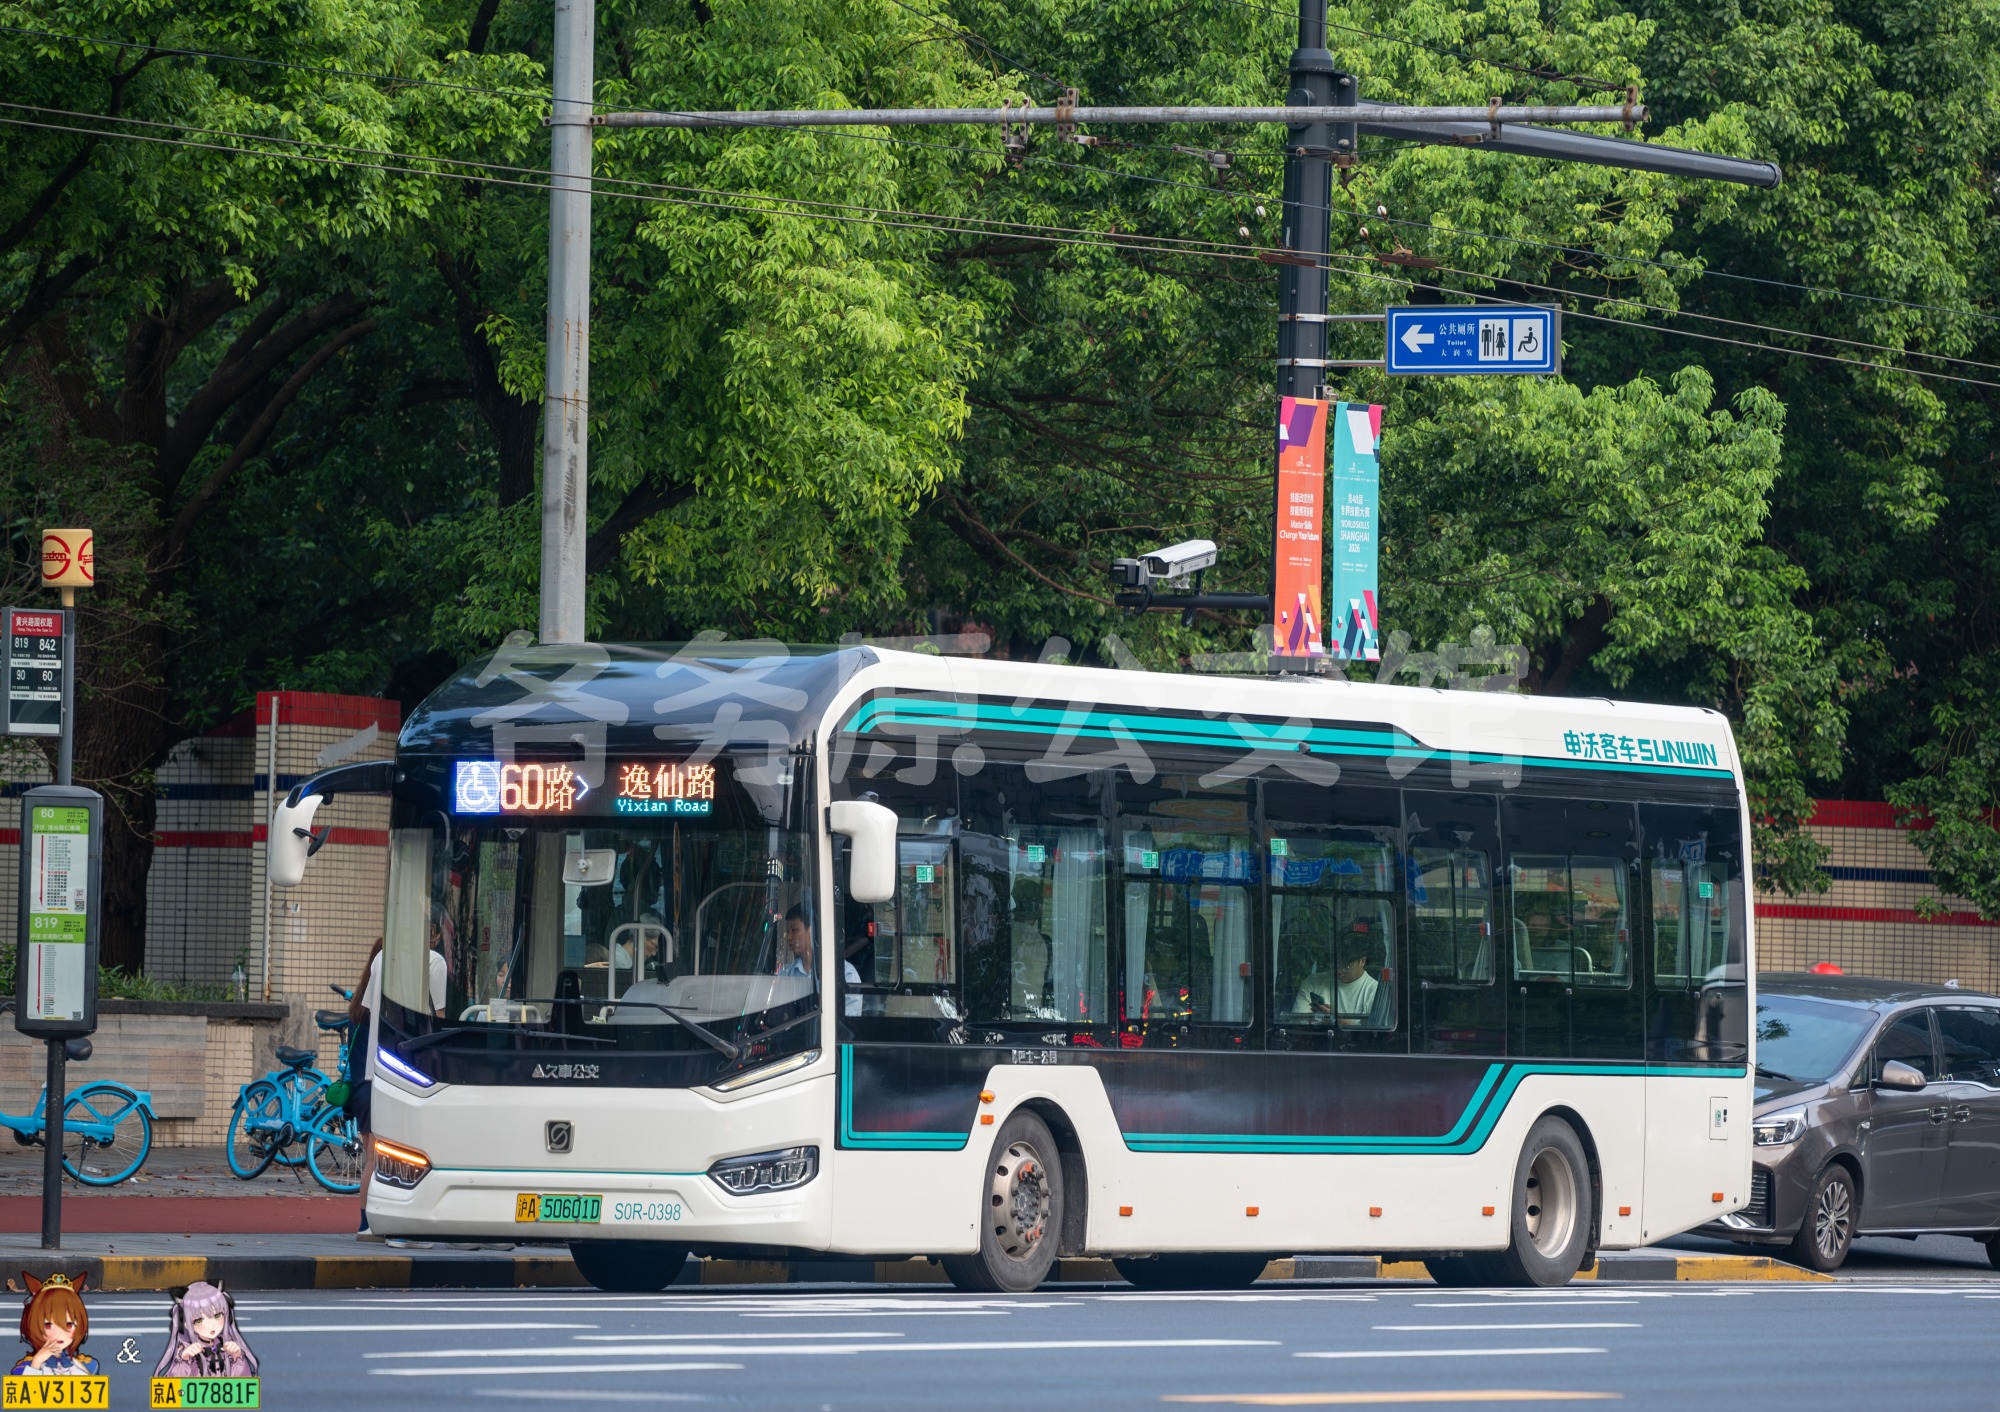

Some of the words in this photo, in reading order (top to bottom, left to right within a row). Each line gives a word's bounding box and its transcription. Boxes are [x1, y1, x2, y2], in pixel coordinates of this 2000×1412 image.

[1439, 323, 1475, 335] 公共厕所
[1280, 530, 1298, 541] Change
[1340, 530, 1370, 542] SHANGHAI
[1348, 543, 1360, 553] 2026
[14, 637, 29, 648] 819
[39, 639, 56, 651] 842
[16, 669, 26, 680] 90
[42, 670, 53, 681] 60
[1563, 729, 1638, 762] 申沃客车
[1637, 738, 1718, 766] SUNWIN
[499, 764, 576, 811] 60路
[619, 763, 716, 799] 逸仙路
[617, 799, 668, 812] Yixian
[675, 800, 709, 812] Road
[41, 808, 54, 818] 60
[34, 917, 58, 928] 819
